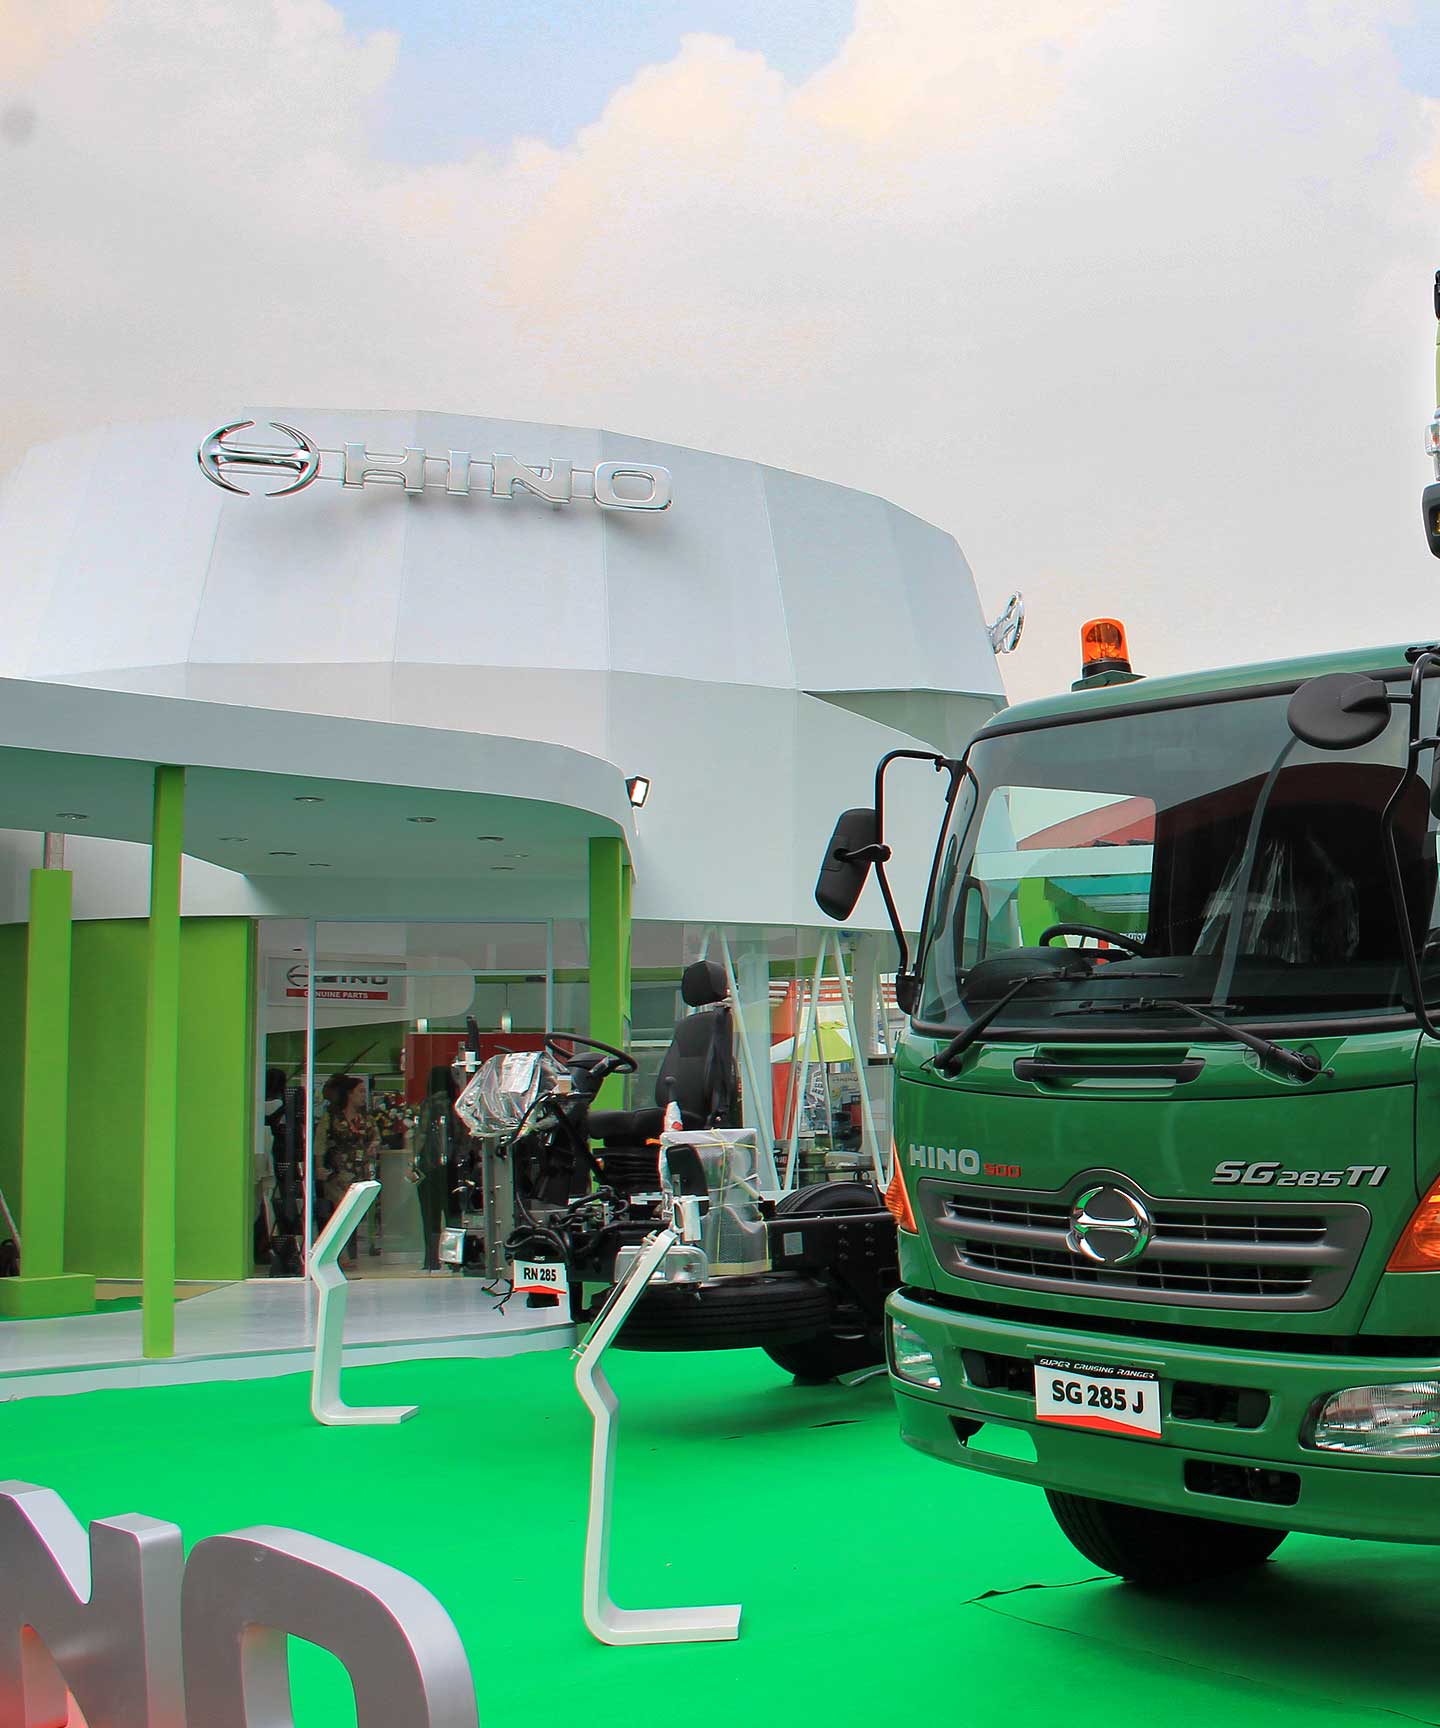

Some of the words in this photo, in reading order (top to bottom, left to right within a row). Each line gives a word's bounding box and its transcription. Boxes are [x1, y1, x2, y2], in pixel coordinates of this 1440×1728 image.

[342, 441, 674, 512] HINO
[303, 990, 341, 999] GNUINE
[342, 990, 369, 999] PARTS
[909, 1143, 980, 1175] HINO
[983, 1163, 1022, 1178] 500
[523, 1267, 538, 1280] RN
[540, 1268, 557, 1281] 285
[1040, 1358, 1071, 1369] SUPER
[1073, 1363, 1114, 1374] CRUISING
[1117, 1368, 1155, 1379] RANGER
[1052, 1379, 1083, 1405] SG
[1087, 1384, 1127, 1411] 285
[1131, 1391, 1144, 1414] J
